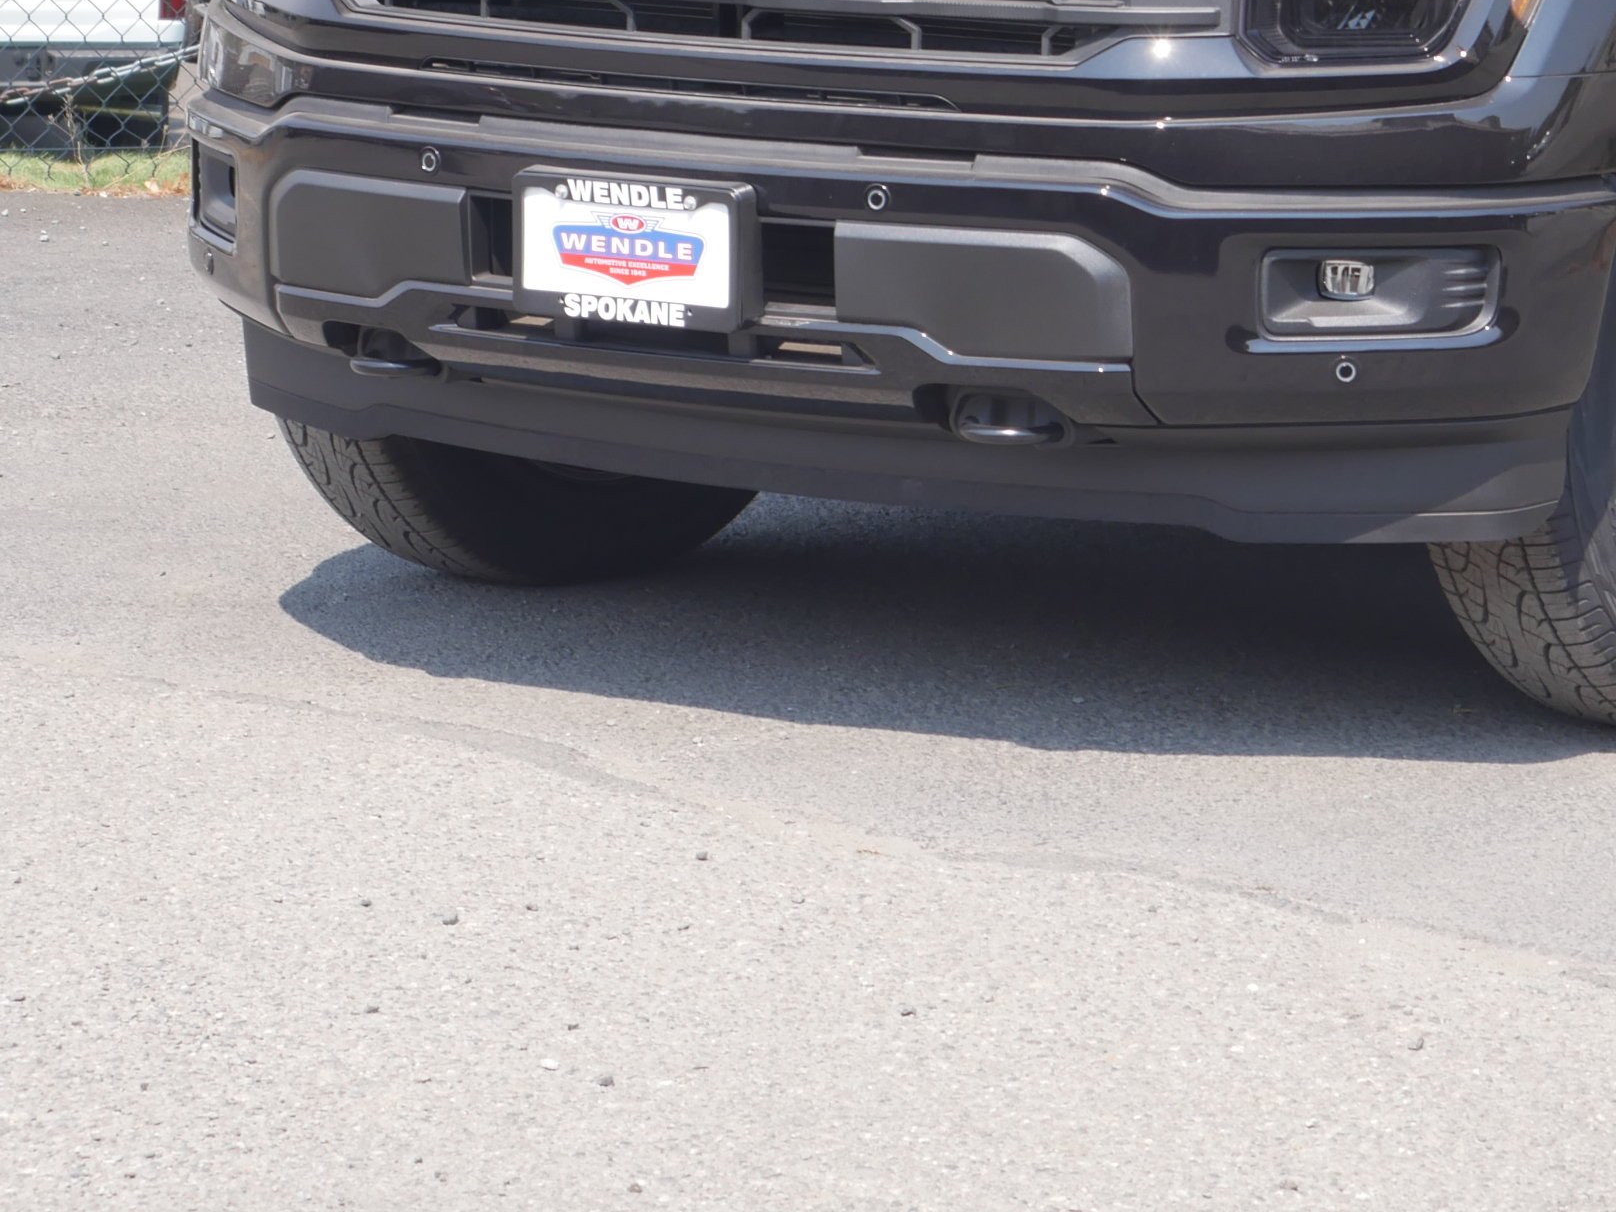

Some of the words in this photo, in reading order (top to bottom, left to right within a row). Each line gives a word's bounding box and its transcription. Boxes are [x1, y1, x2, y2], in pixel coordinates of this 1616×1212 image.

[567, 179, 685, 210] WENDLE
[560, 233, 693, 261] WENDLE
[584, 257, 627, 267] AUTOMOTIVE
[628, 261, 670, 271] EXCELLENCE
[609, 267, 630, 275] SINCE
[564, 294, 686, 328] SPOKANE
